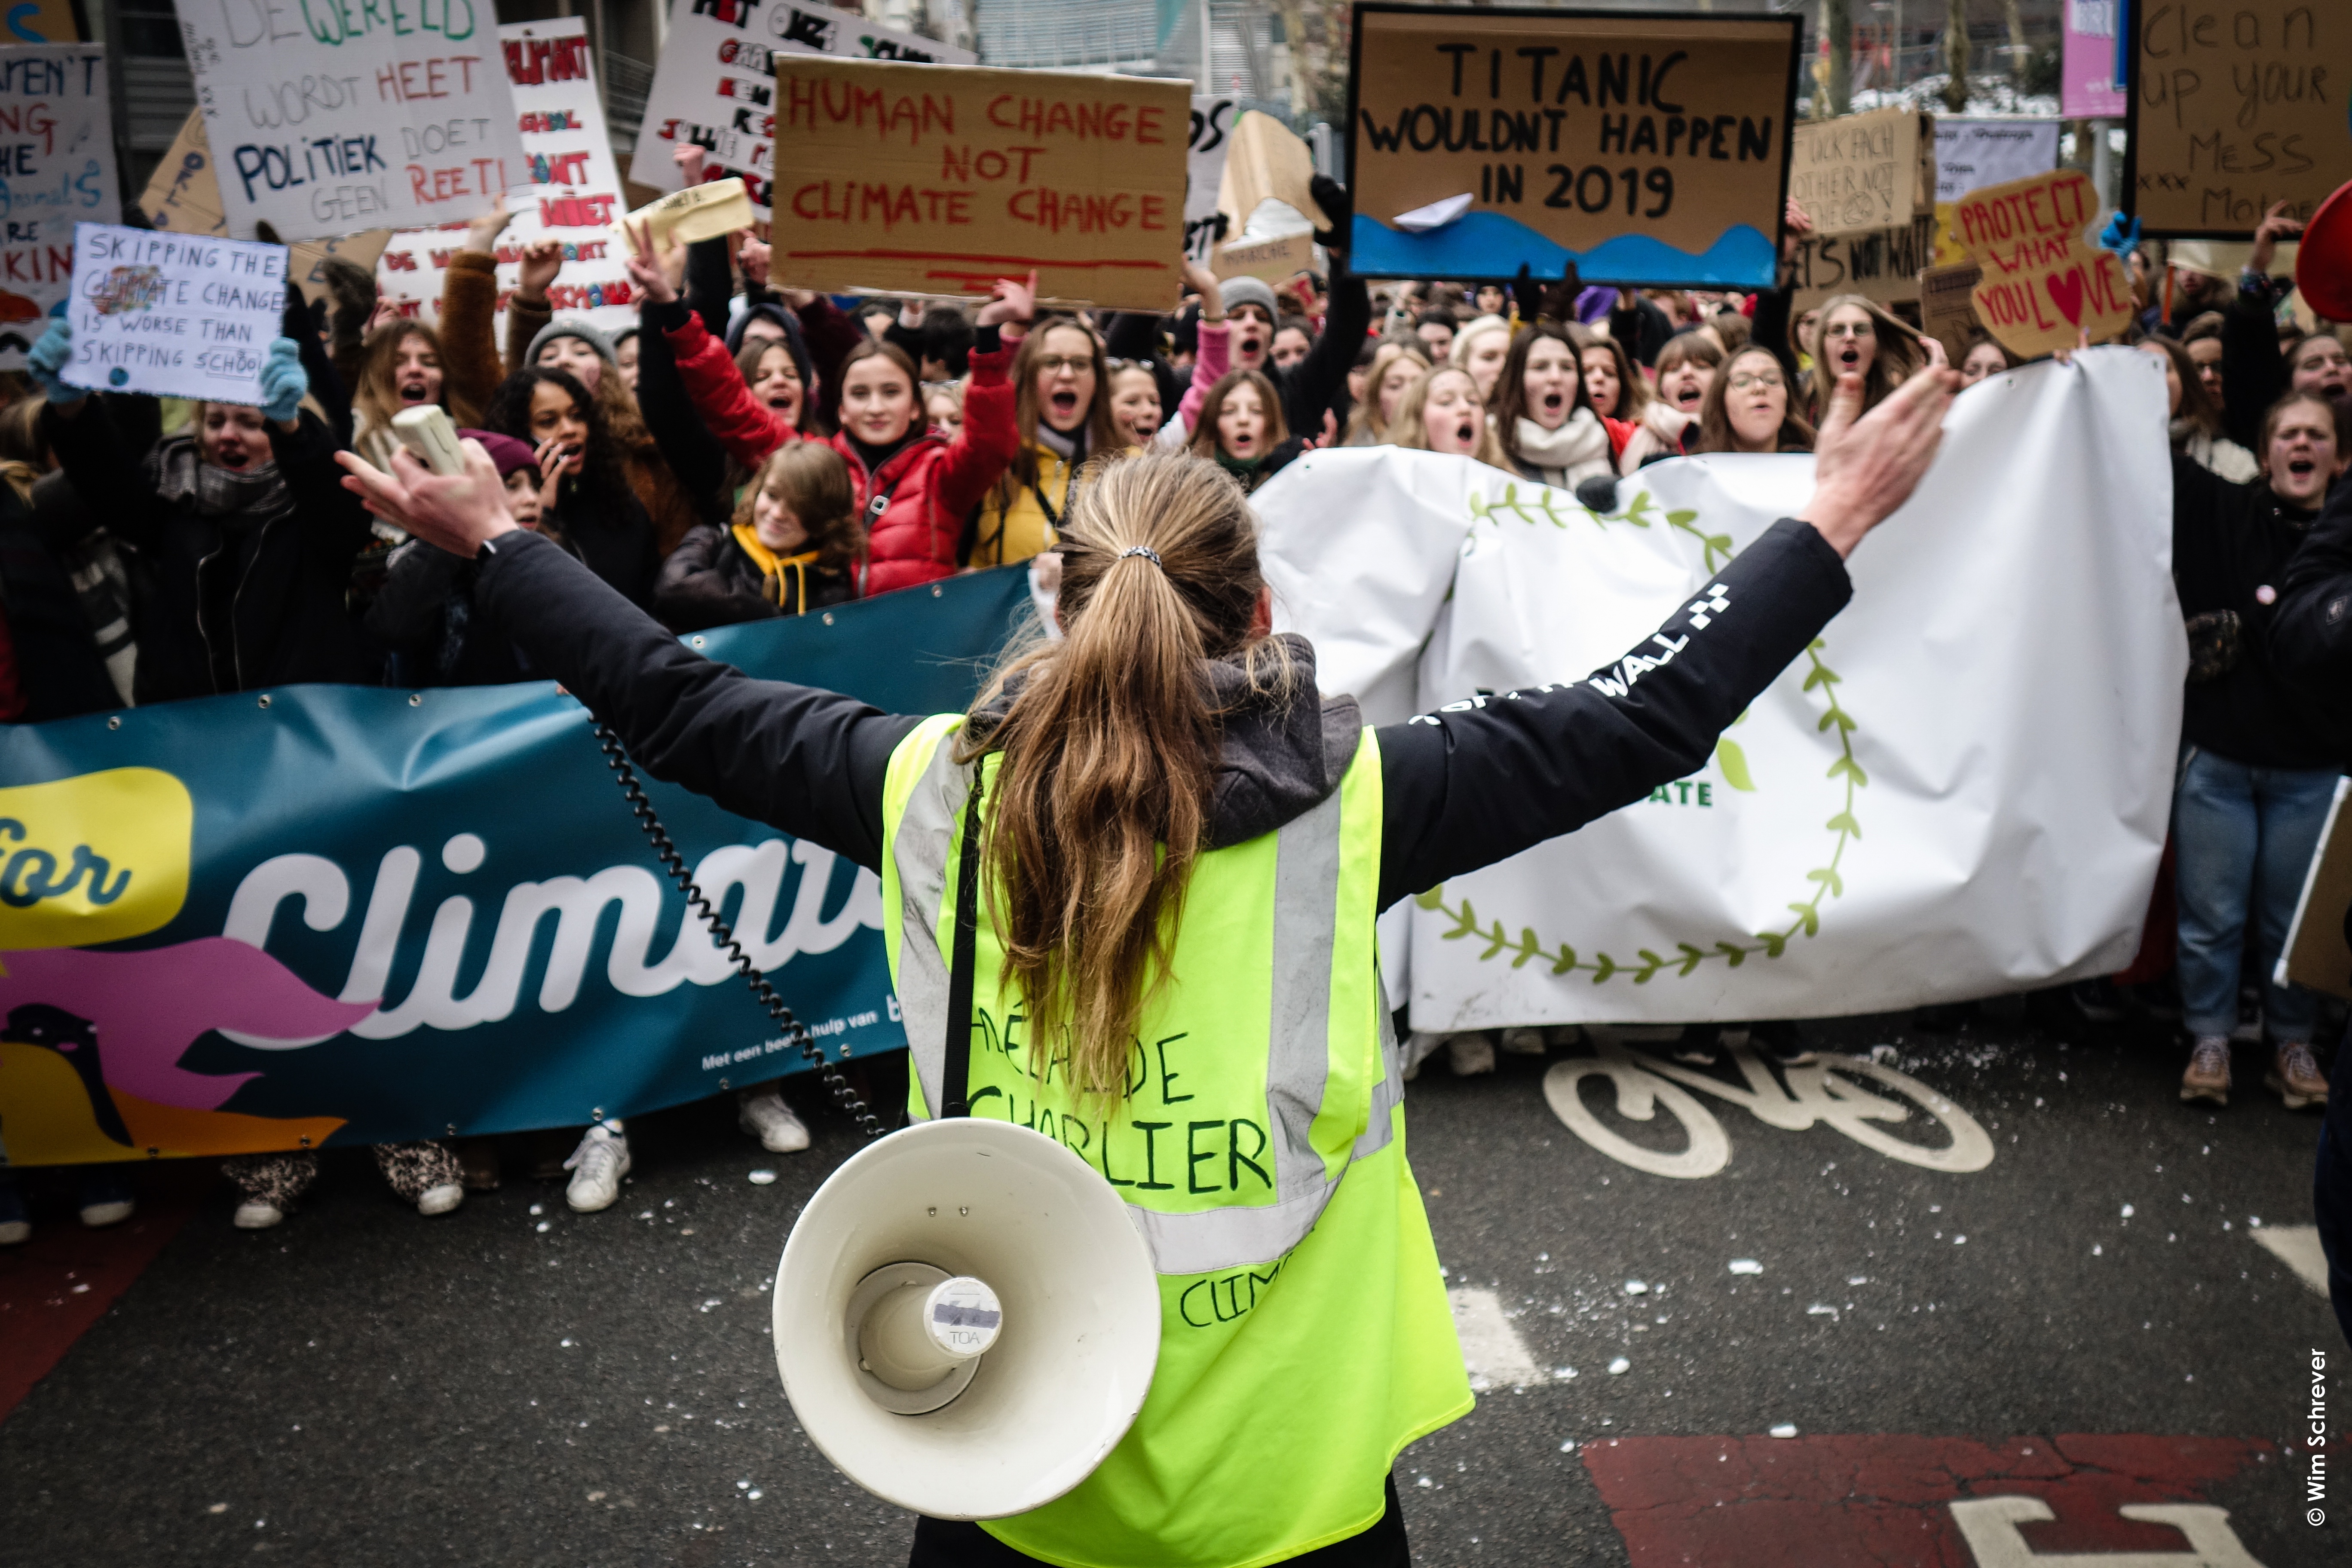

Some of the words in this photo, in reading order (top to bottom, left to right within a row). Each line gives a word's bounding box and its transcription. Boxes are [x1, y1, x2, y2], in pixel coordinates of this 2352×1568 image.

[223, 0, 303, 48] DE
[300, 0, 475, 46] WERELD
[2143, 3, 2315, 59] Clean
[243, 74, 361, 129] WORDT
[375, 55, 482, 103] HEET
[1436, 42, 1688, 113] TITANIC
[2140, 68, 2202, 130] up
[788, 76, 956, 146] HUMAN
[986, 94, 1166, 145] CHANGE
[1360, 104, 1568, 154] WOULDNT
[1600, 113, 1772, 161] HAPPEN
[401, 118, 491, 160] DOET
[941, 144, 1047, 184] NOT
[1794, 165, 1856, 199] OTHER
[311, 175, 388, 223] GEEN
[1007, 187, 1167, 234] CHANGE
[1480, 163, 1523, 204] IN
[1544, 163, 1674, 218] 2019
[1958, 175, 2087, 246] PROTECT
[231, 251, 279, 277] THE
[1989, 230, 2073, 274] WHAT
[202, 282, 284, 312] CHANGE
[1977, 277, 2029, 327] YOU
[83, 314, 103, 333] IS
[120, 315, 188, 336] WORSE
[201, 318, 253, 343] THAN
[193, 349, 263, 371] SCHOOL
[1589, 632, 1690, 697] WALL
[1649, 780, 1712, 807] ATE
[217, 833, 884, 1051] Climat
[701, 1052, 731, 1071] Met
[733, 1043, 761, 1063] een
[811, 1017, 846, 1038] hulp
[848, 1010, 879, 1029] van
[1180, 1252, 1294, 1328] CLIM
[949, 1331, 980, 1344] TOA
